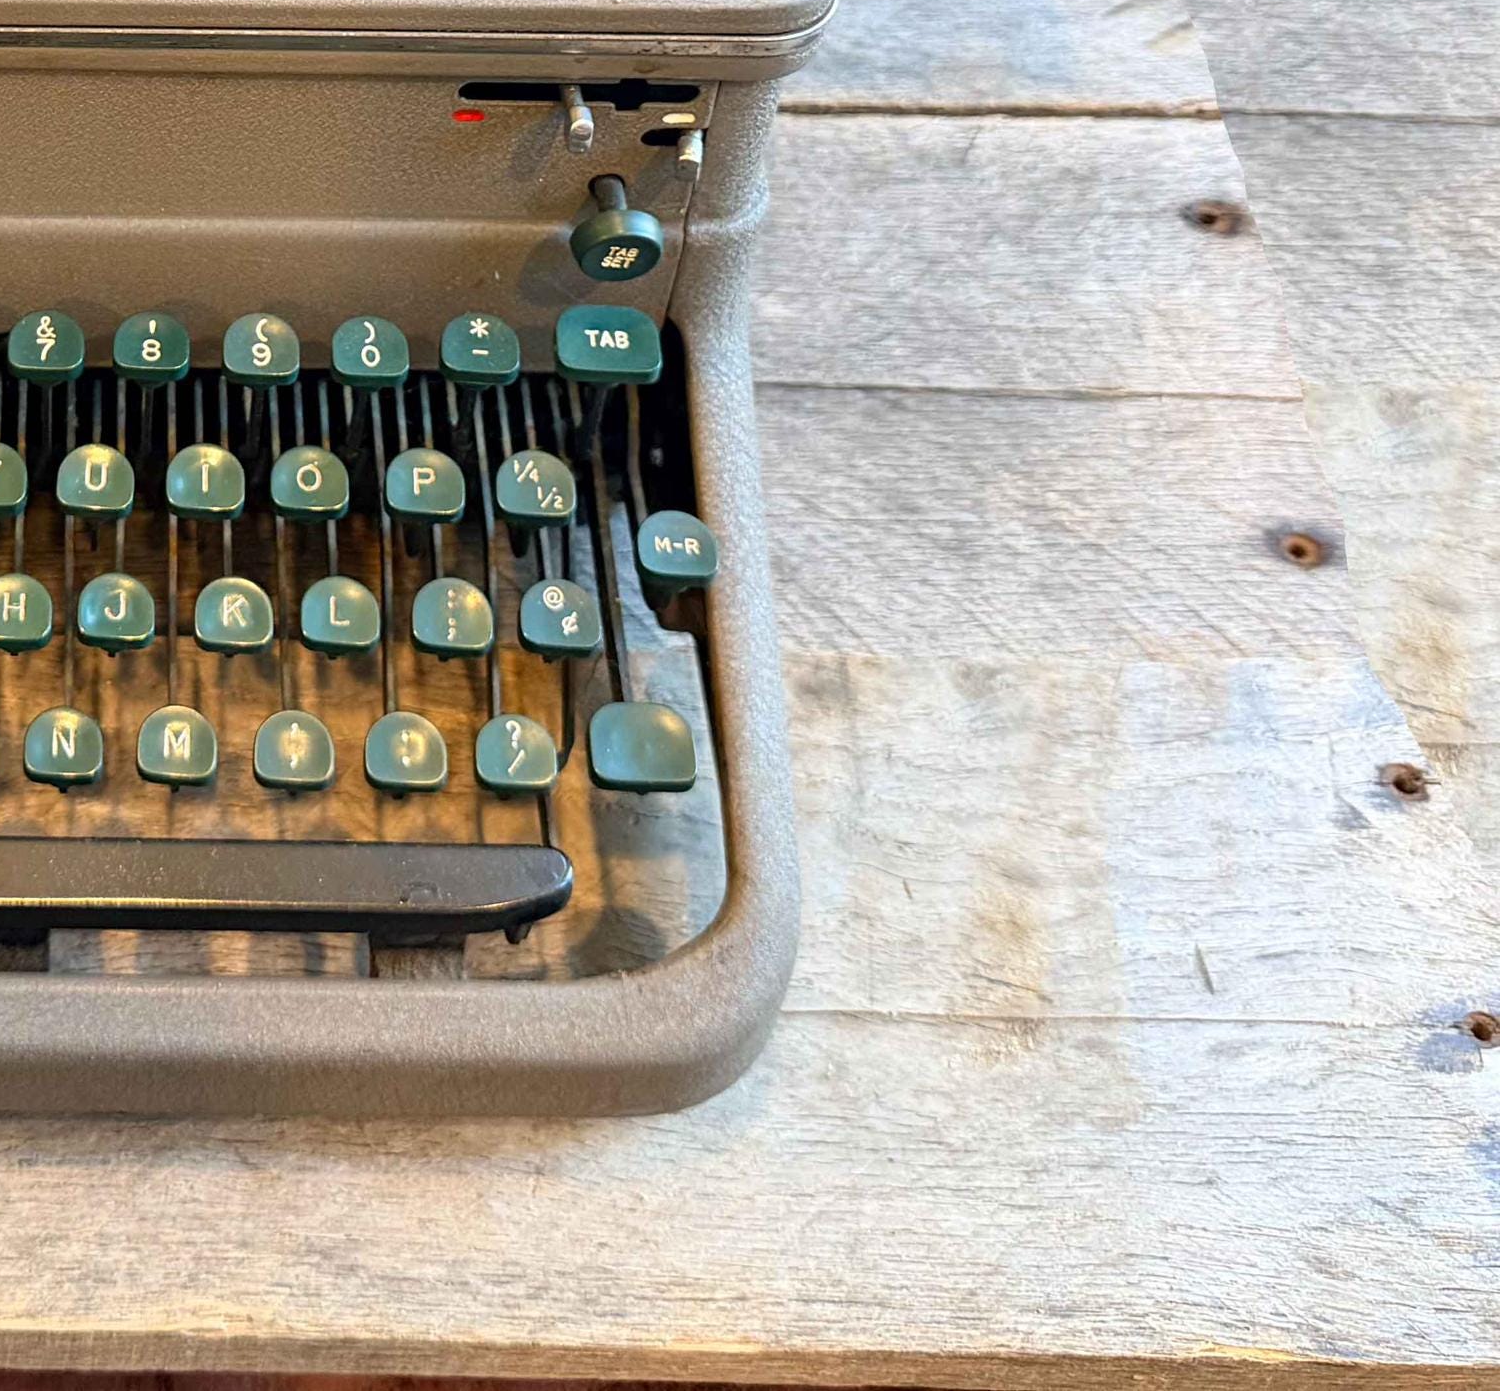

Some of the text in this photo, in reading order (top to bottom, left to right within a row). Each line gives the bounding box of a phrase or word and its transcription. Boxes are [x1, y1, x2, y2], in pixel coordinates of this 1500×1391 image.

[601, 257, 635, 269] SET
[608, 246, 640, 258] TAB
[37, 316, 57, 339] &
[256, 318, 268, 341] (
[364, 321, 375, 344] )
[584, 329, 630, 349] TAB
[36, 339, 56, 361] 7
[142, 339, 161, 361] 8
[252, 343, 272, 366] 9
[361, 345, 380, 368] 0
[84, 459, 108, 491] U
[201, 463, 209, 493] I
[296, 464, 322, 491] O
[412, 467, 436, 495] P
[654, 536, 700, 555] M-R
[2, 593, 27, 623] H
[104, 588, 126, 621] J
[222, 594, 249, 628] K
[328, 595, 350, 626] L
[542, 585, 564, 611] @
[51, 724, 76, 760] N
[163, 723, 191, 760] M
[505, 720, 522, 749] ?
